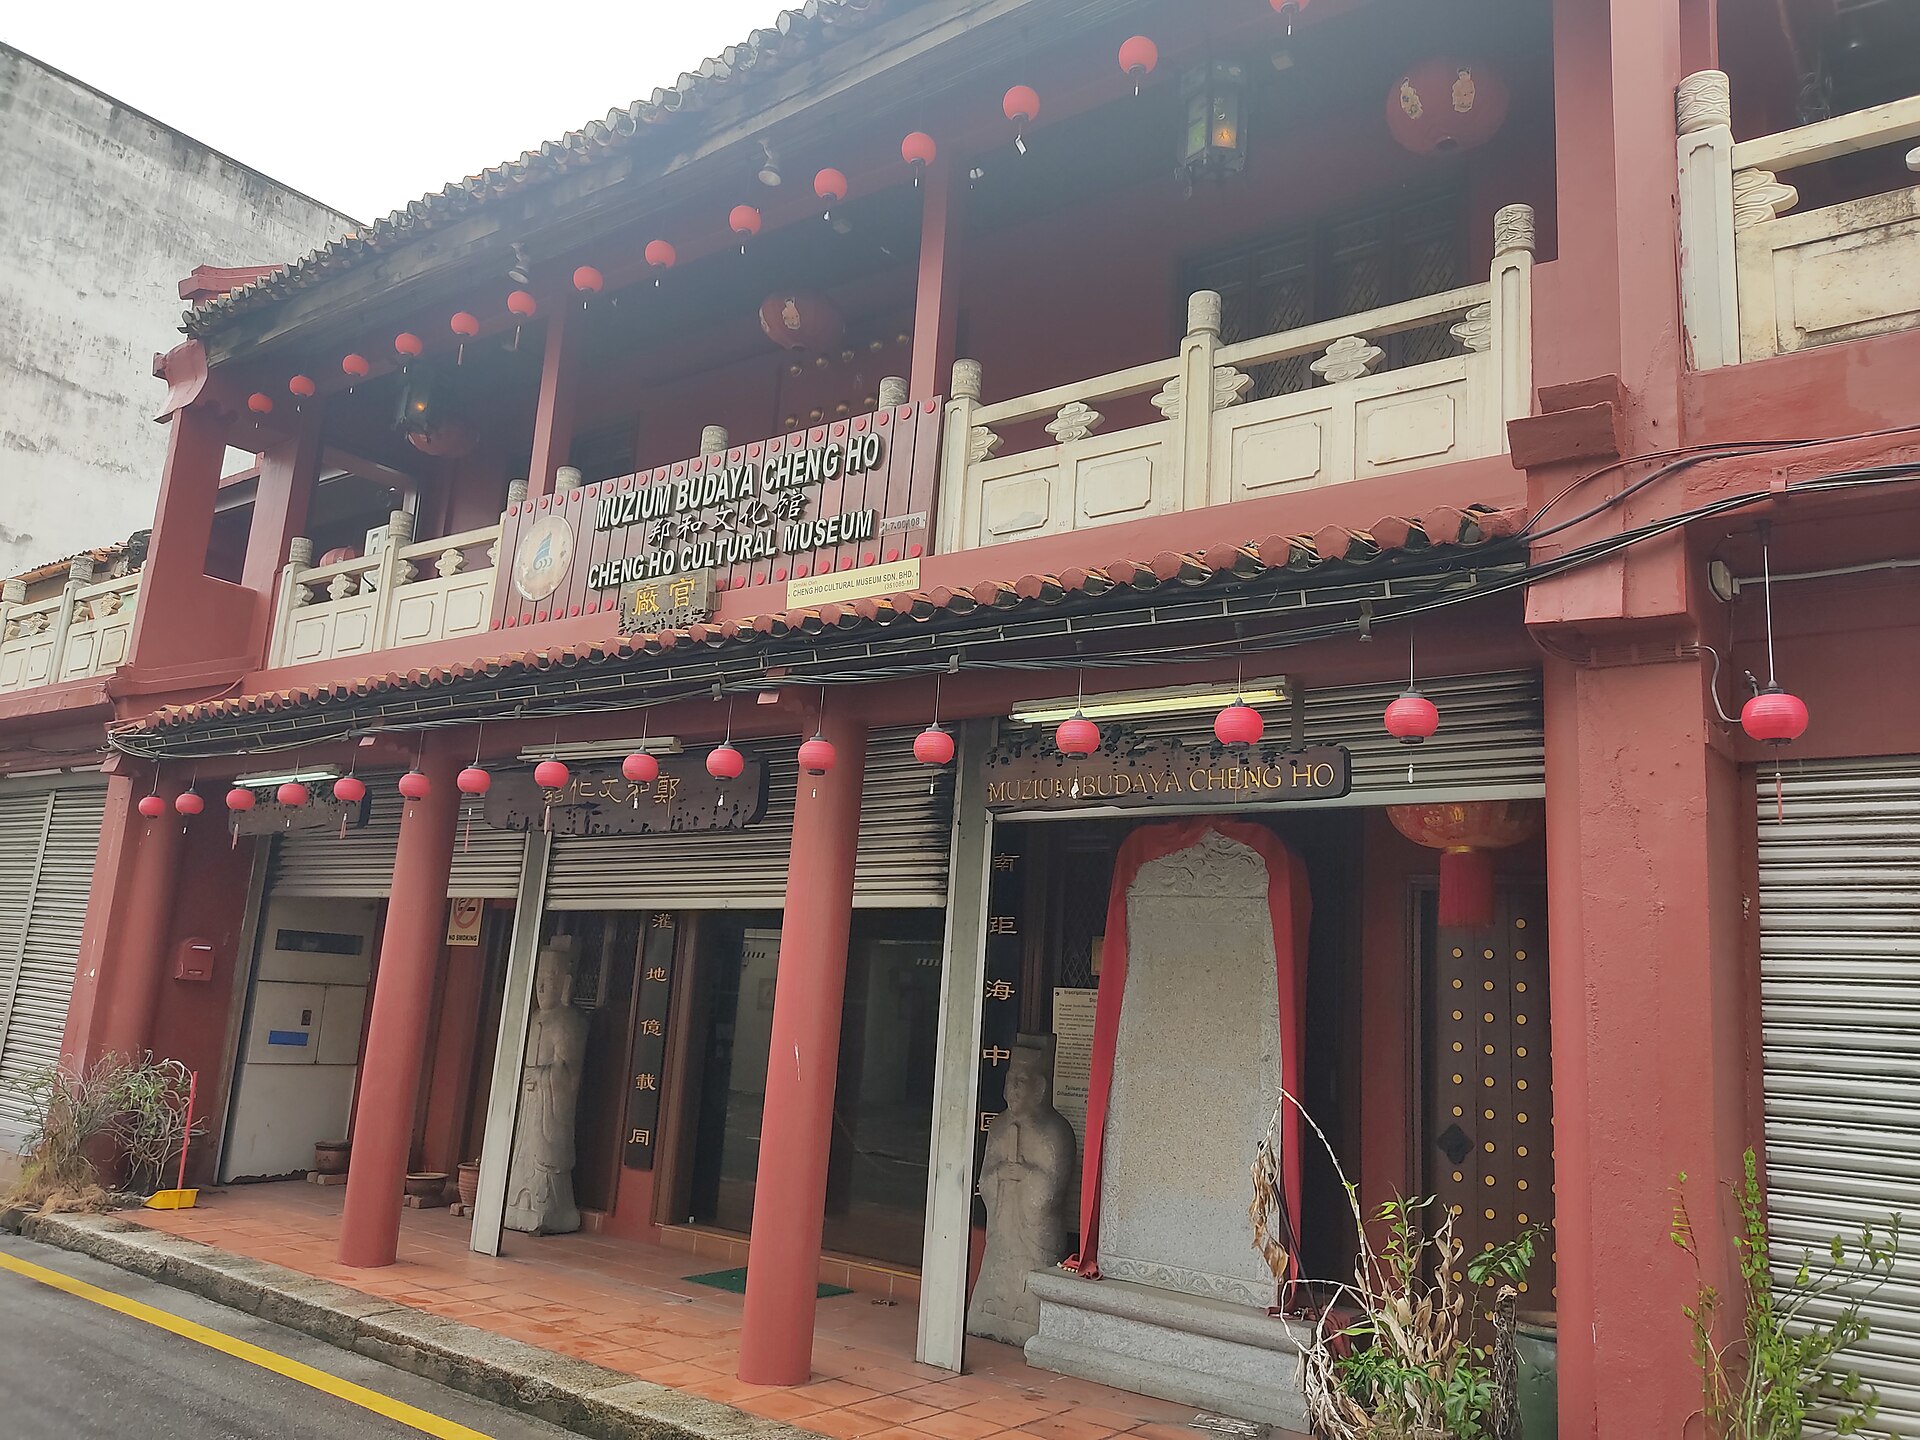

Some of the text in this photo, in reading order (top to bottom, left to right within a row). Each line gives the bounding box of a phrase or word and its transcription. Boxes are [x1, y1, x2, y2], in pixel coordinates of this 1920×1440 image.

[594, 432, 880, 531] MUZIUM BUDAYA CHENG HO
[648, 488, 807, 549] 郑和文化馆
[588, 508, 873, 590] CHENG HO CULTURAL MUSEUM
[792, 570, 914, 598] CHENG HO CULTURAL MUSEUM SDN. BHD.
[1081, 771, 1182, 796] BUDAYA
[1189, 764, 1282, 792] CHENG
[1291, 763, 1335, 788] HO
[456, 934, 478, 942] SMOKING
